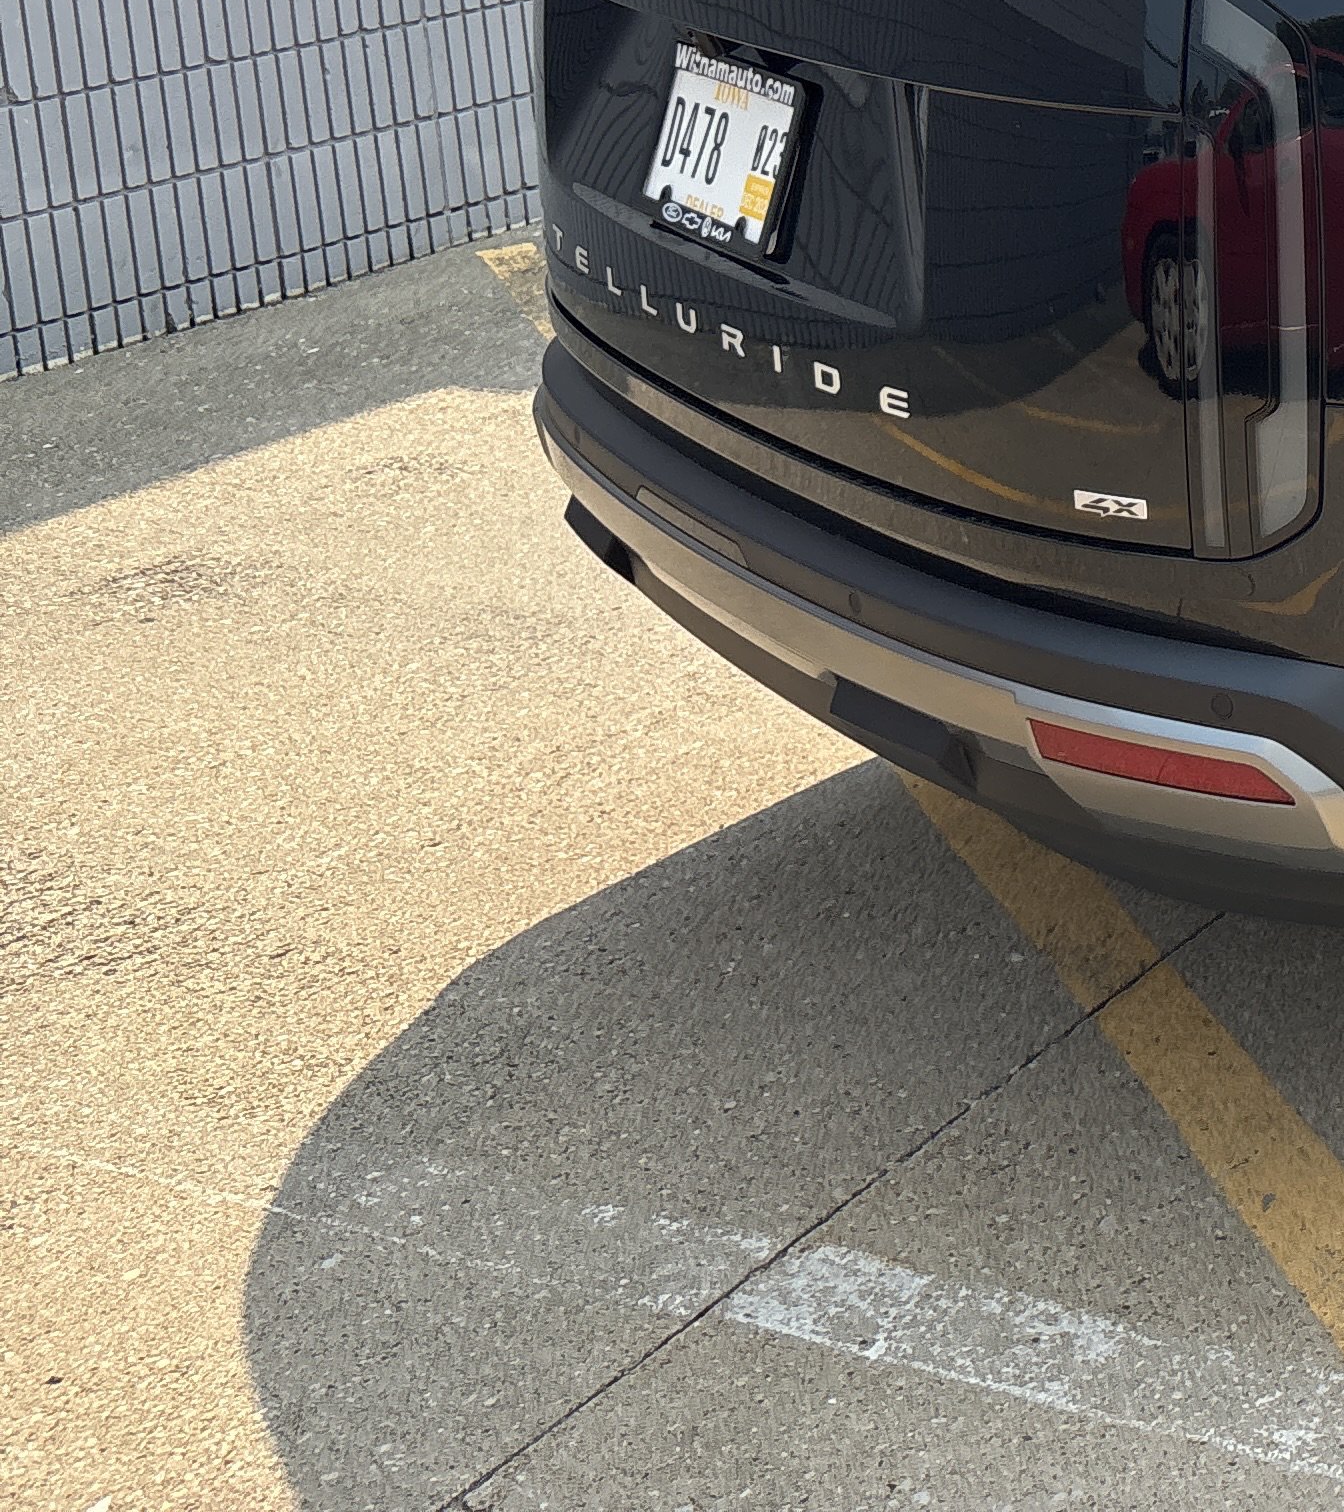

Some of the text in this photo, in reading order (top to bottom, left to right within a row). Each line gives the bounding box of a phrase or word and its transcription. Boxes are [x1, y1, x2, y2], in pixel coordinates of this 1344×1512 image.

[661, 96, 730, 185] D478
[714, 83, 750, 111] IOWA
[552, 224, 911, 419] TELLURIDE
